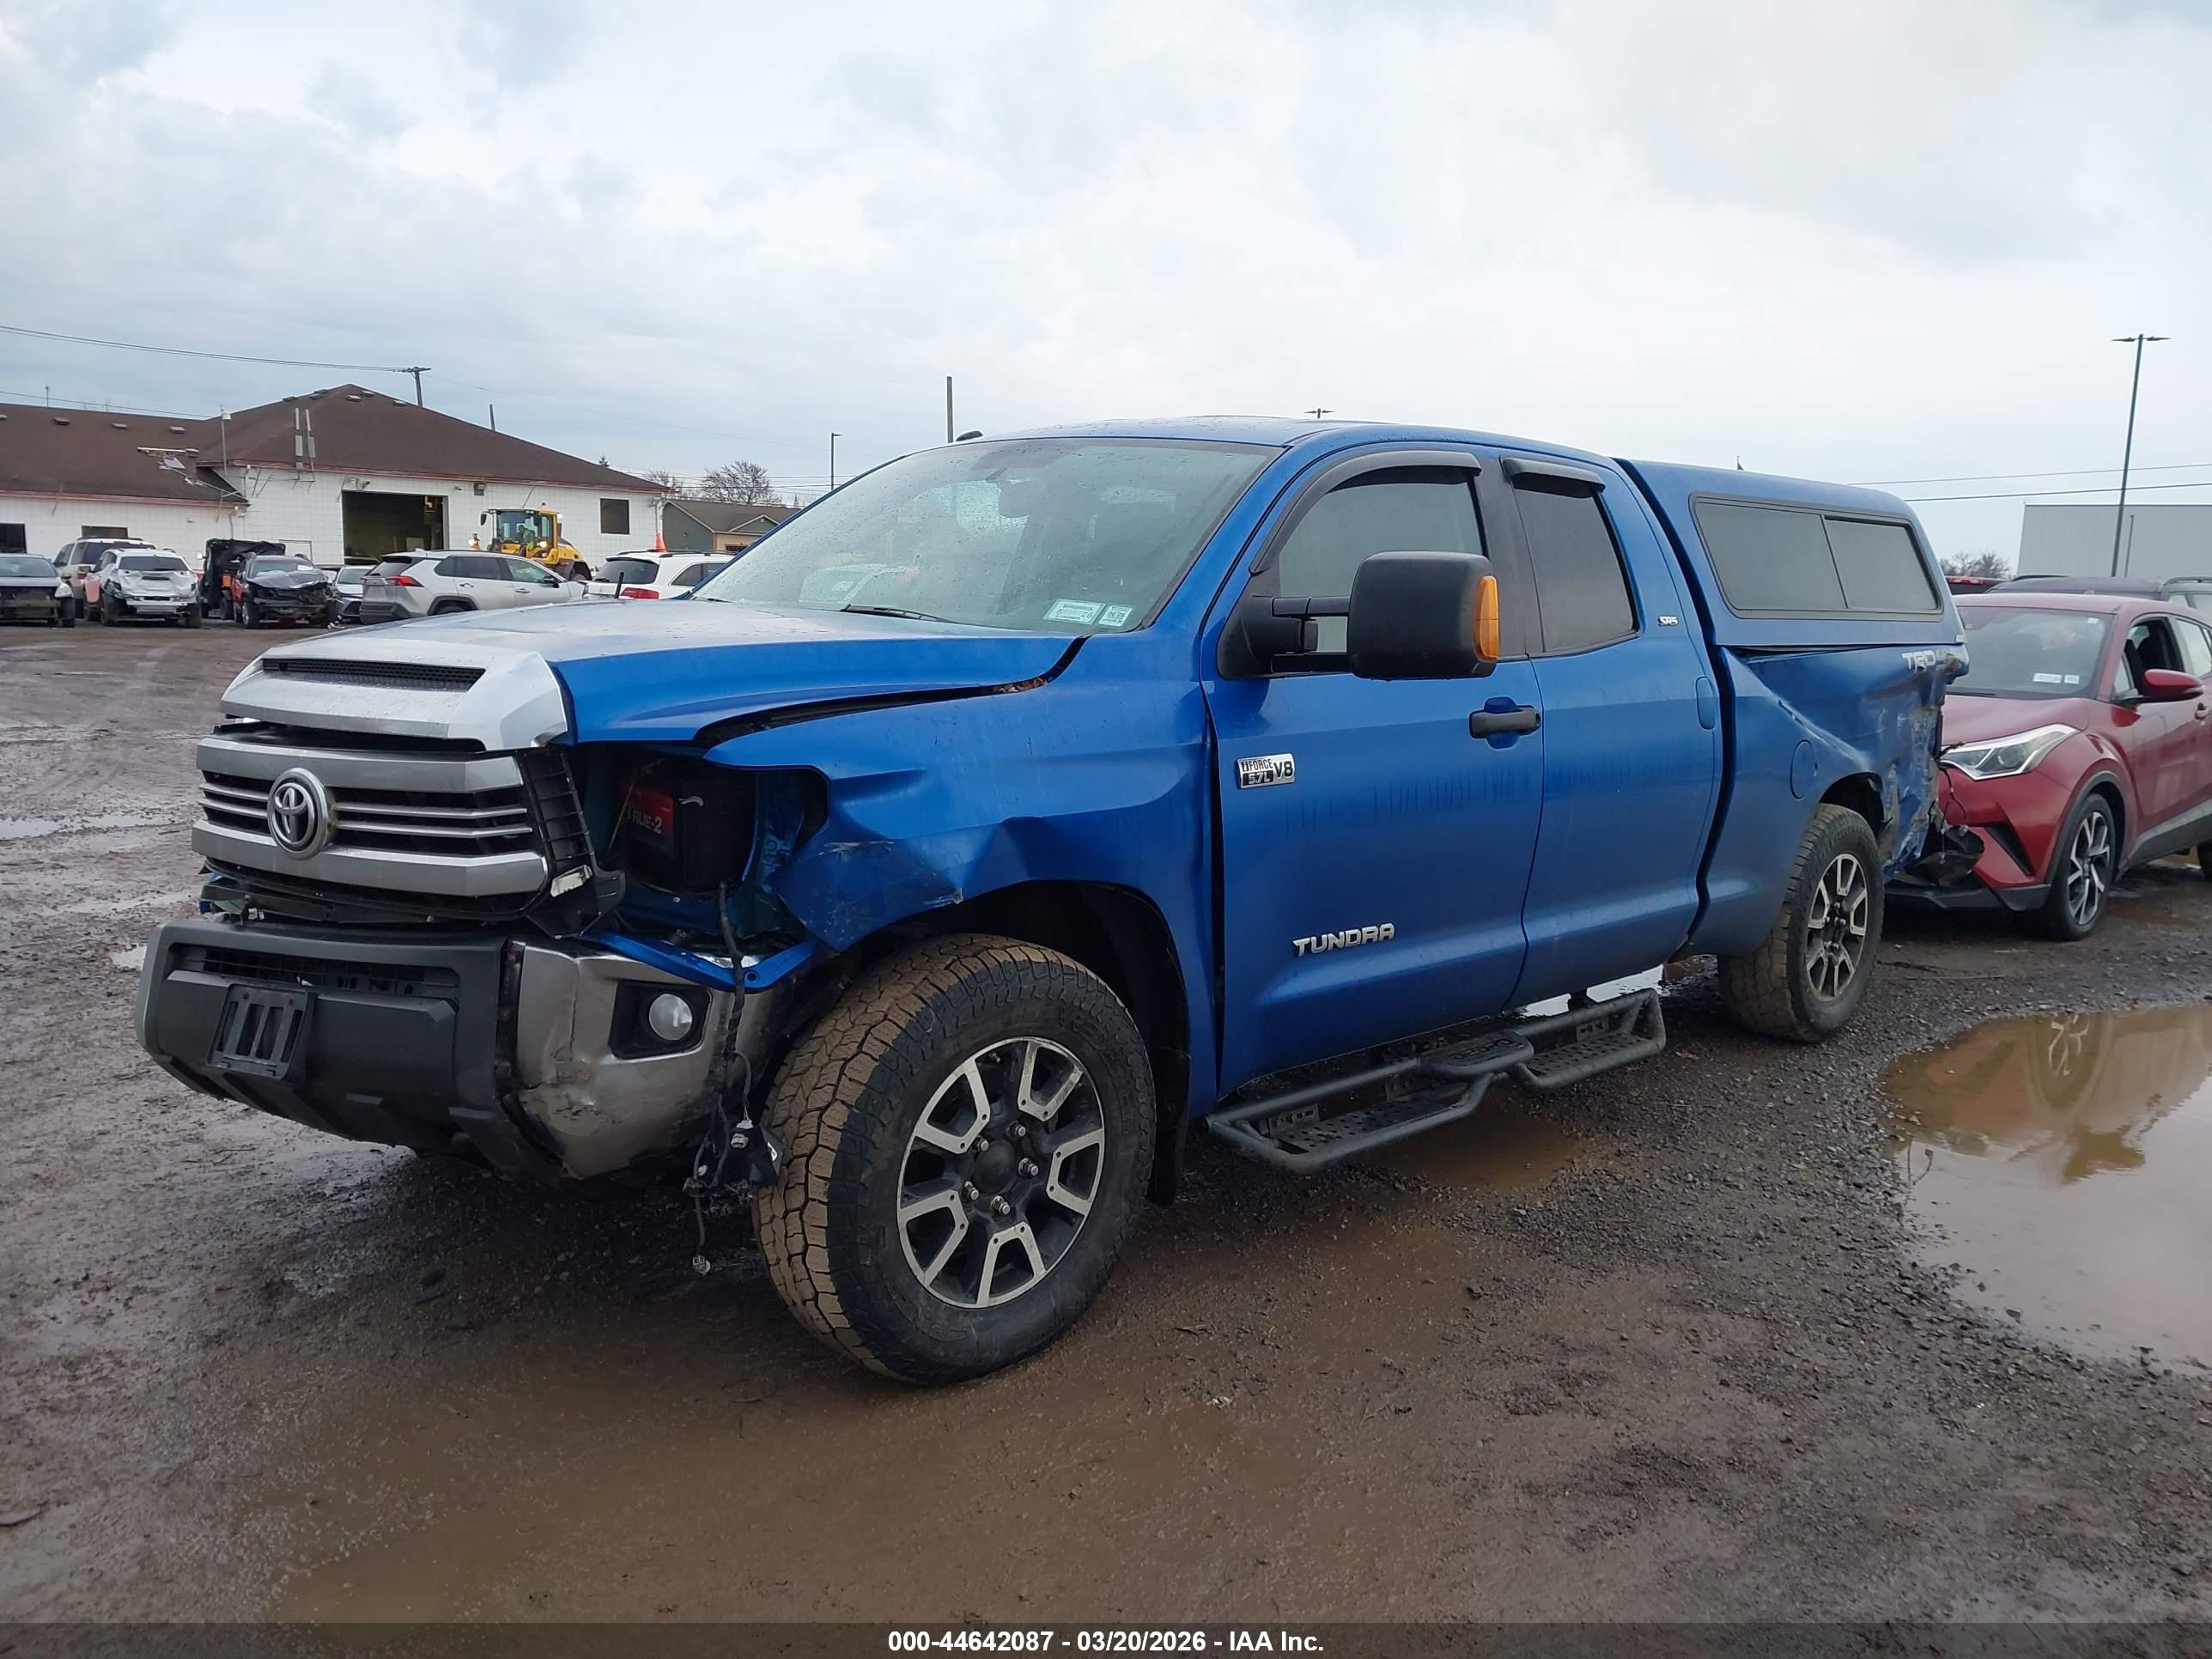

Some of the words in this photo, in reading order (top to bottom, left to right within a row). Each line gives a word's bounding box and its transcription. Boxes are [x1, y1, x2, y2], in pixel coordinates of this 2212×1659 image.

[1658, 616, 1678, 626] SR5
[1901, 650, 1936, 673] TRD
[1273, 761, 1293, 778] V8
[1292, 922, 1395, 957] TUNDRA
